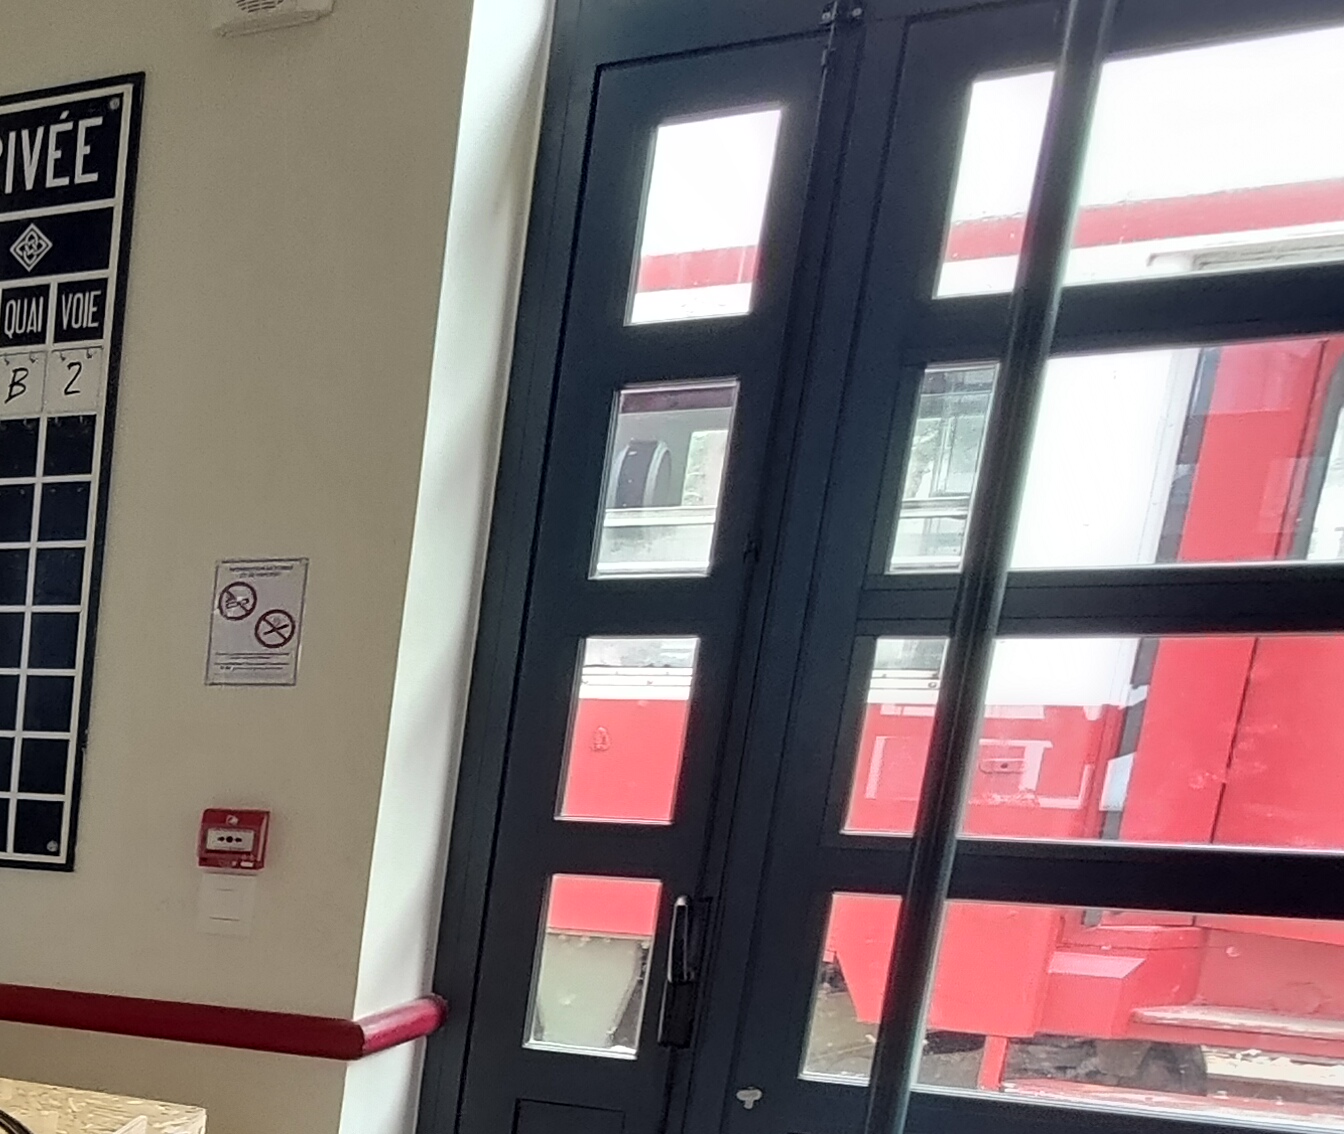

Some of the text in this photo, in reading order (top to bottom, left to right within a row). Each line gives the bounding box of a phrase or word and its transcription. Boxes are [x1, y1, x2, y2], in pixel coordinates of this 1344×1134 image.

[4, 296, 43, 338] QUAI
[61, 290, 101, 330] VOIE
[4, 368, 29, 404] B
[64, 361, 82, 395] 2
